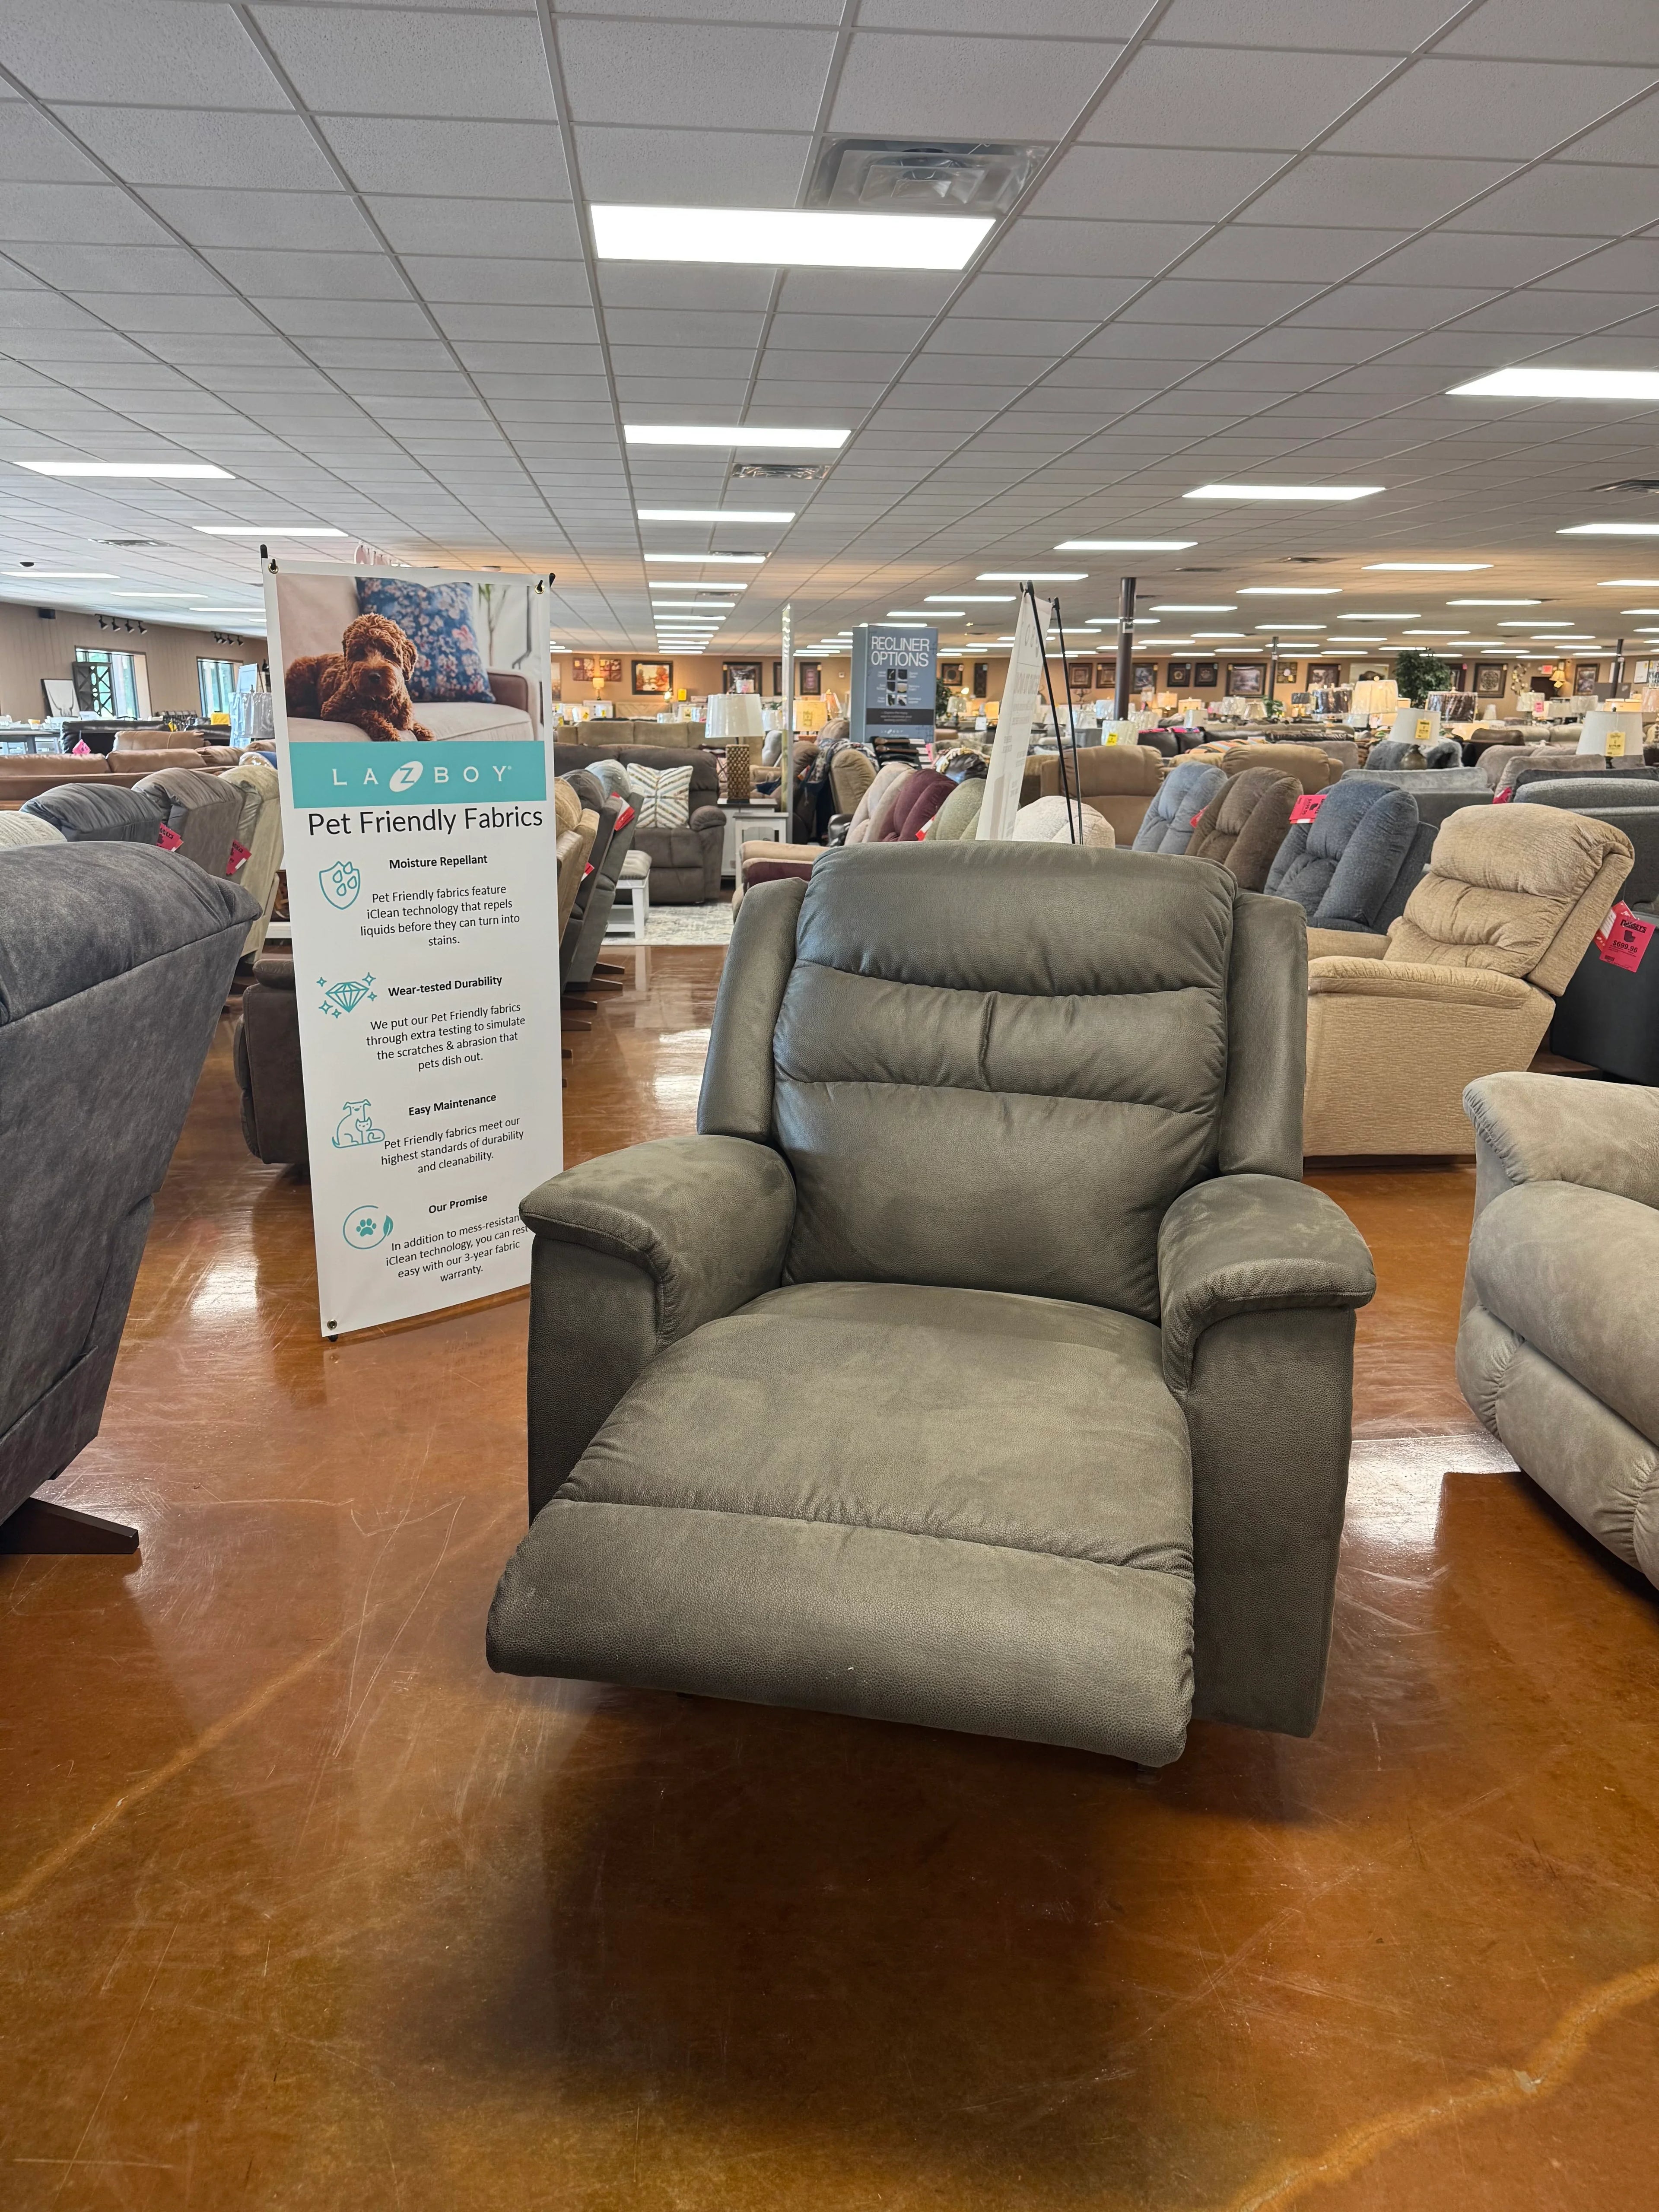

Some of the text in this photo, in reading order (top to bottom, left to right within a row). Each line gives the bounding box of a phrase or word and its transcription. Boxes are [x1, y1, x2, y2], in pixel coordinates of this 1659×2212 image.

[871, 636, 930, 652] RECLINER
[871, 651, 929, 667] OPTIONS
[308, 806, 543, 836] Pet Friendly Fabrics
[389, 855, 488, 869] Moisture Repellant
[372, 886, 506, 903] Pet Friendly fabrics feature
[367, 898, 513, 919] iClean technology that repels
[360, 914, 520, 938] liquids before they can turn into
[428, 935, 460, 946] stains.
[1612, 940, 1638, 953] $699.96
[388, 976, 502, 997] Wear-tested Durability
[370, 1003, 521, 1030] We put our Pet Friendly fabrics
[366, 1017, 525, 1046] through extra testing to simulate
[376, 1032, 518, 1060] the scratches & abrasion that
[418, 1052, 483, 1072] pets dish out.
[409, 1095, 496, 1116] Easy Maintenance
[384, 1118, 520, 1150] Pet Friendly fabrics meet our
[381, 1131, 524, 1166] highest standards of durability
[418, 1152, 494, 1173] and cleanability.
[429, 1195, 488, 1214] Our Promise
[391, 1215, 519, 1251] In addition to mess-resistan
[386, 1254, 417, 1266] iClean
[419, 1240, 473, 1259] technology,
[475, 1235, 492, 1247] you
[494, 1230, 510, 1240] can
[398, 1240, 520, 1278] easy with our 3-year fabric
[440, 1265, 483, 1282] warranty.
